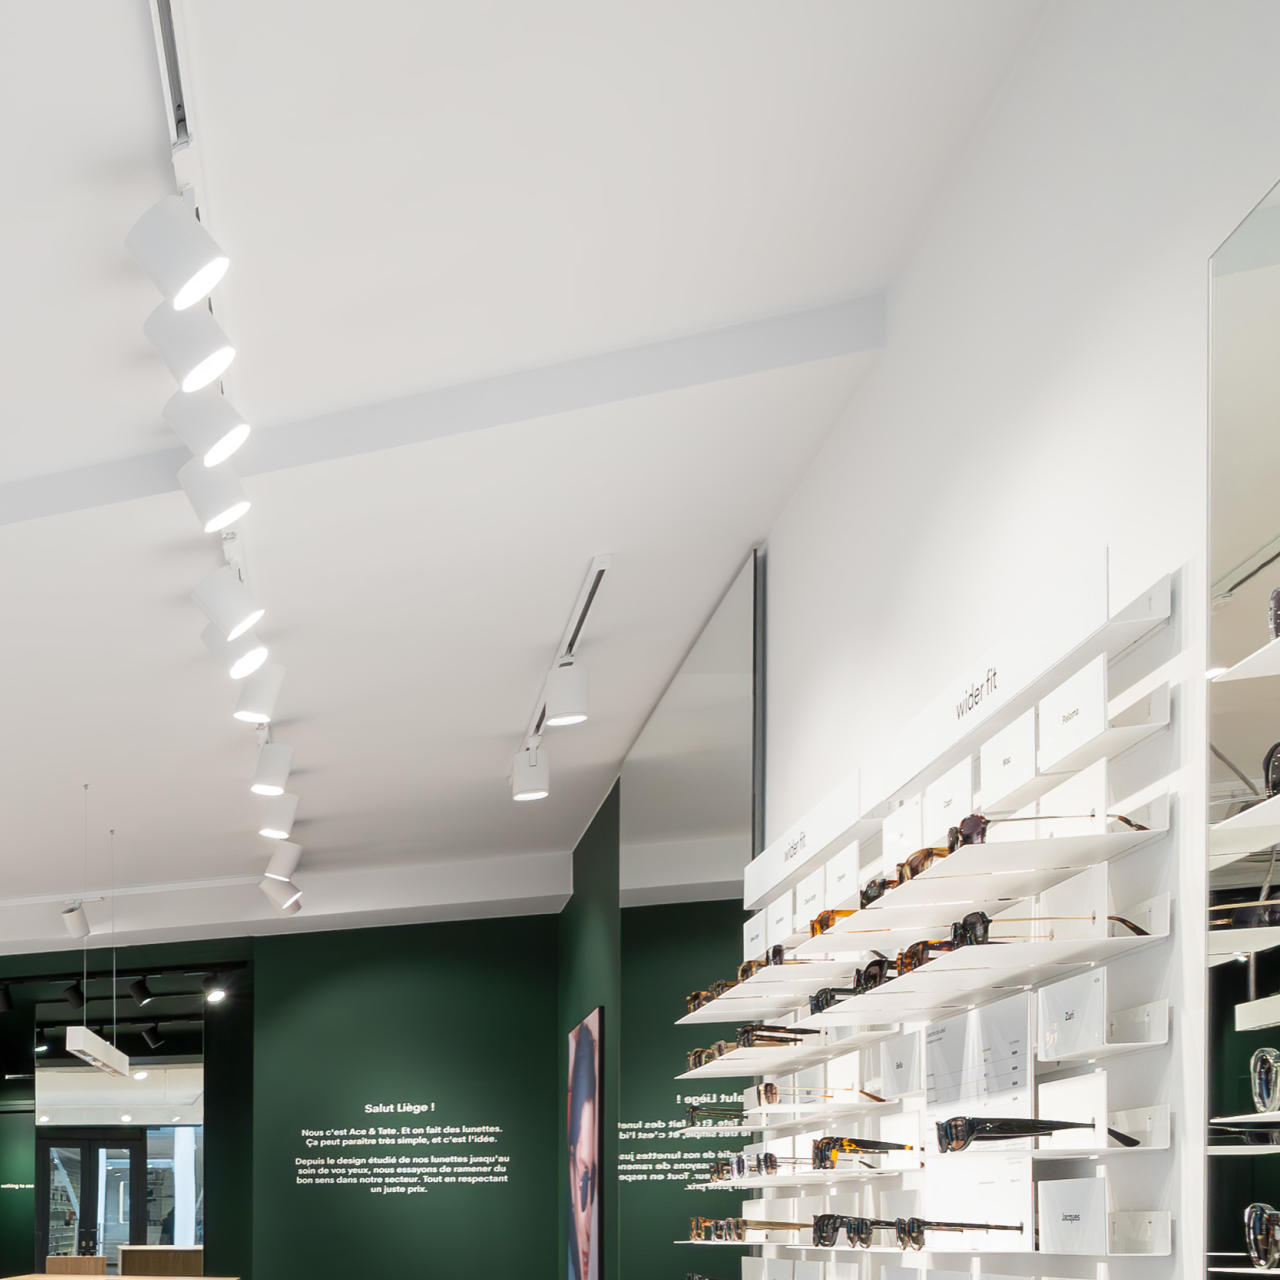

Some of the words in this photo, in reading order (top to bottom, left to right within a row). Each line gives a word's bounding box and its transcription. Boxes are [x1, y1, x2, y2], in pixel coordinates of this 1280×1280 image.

[953, 683, 985, 720] wider
[986, 667, 997, 695] fit
[364, 1103, 395, 1114] Salut
[397, 1102, 429, 1115] Liège
[430, 1102, 435, 1112] !
[301, 1129, 324, 1137] Nous
[325, 1128, 348, 1136] c'est
[349, 1128, 367, 1136] Ace
[368, 1127, 376, 1136] &
[377, 1127, 400, 1135] Tate.
[401, 1126, 411, 1135] Et
[425, 1125, 442, 1134] fait
[443, 1125, 460, 1134] des
[462, 1125, 503, 1133] lunettes.
[305, 1138, 319, 1148] Ça
[320, 1138, 341, 1147] peut
[342, 1137, 377, 1147] paraître
[378, 1136, 396, 1145] très
[397, 1135, 430, 1146] simple,
[431, 1136, 442, 1144] et
[443, 1135, 467, 1144] c'est
[468, 1134, 498, 1143] l'idée.
[295, 1156, 326, 1167] Depuis
[326, 1156, 336, 1165] le
[336, 1156, 367, 1166] design
[368, 1155, 397, 1165] étudié
[398, 1155, 411, 1164] de
[430, 1155, 469, 1164] lunettes
[469, 1154, 510, 1165] jusqu'au
[297, 1166, 316, 1175] soin
[317, 1166, 330, 1175] de
[347, 1168, 372, 1176] yeux,
[396, 1167, 438, 1175] essayons
[438, 1164, 452, 1173] de
[493, 1164, 507, 1172] du
[296, 1176, 314, 1184] bon
[336, 1175, 358, 1184] dans
[384, 1175, 421, 1183] secteur.
[422, 1175, 443, 1183] Tout
[457, 1175, 509, 1185] respectant
[383, 1185, 406, 1195] juste
[407, 1184, 428, 1195] prix.
